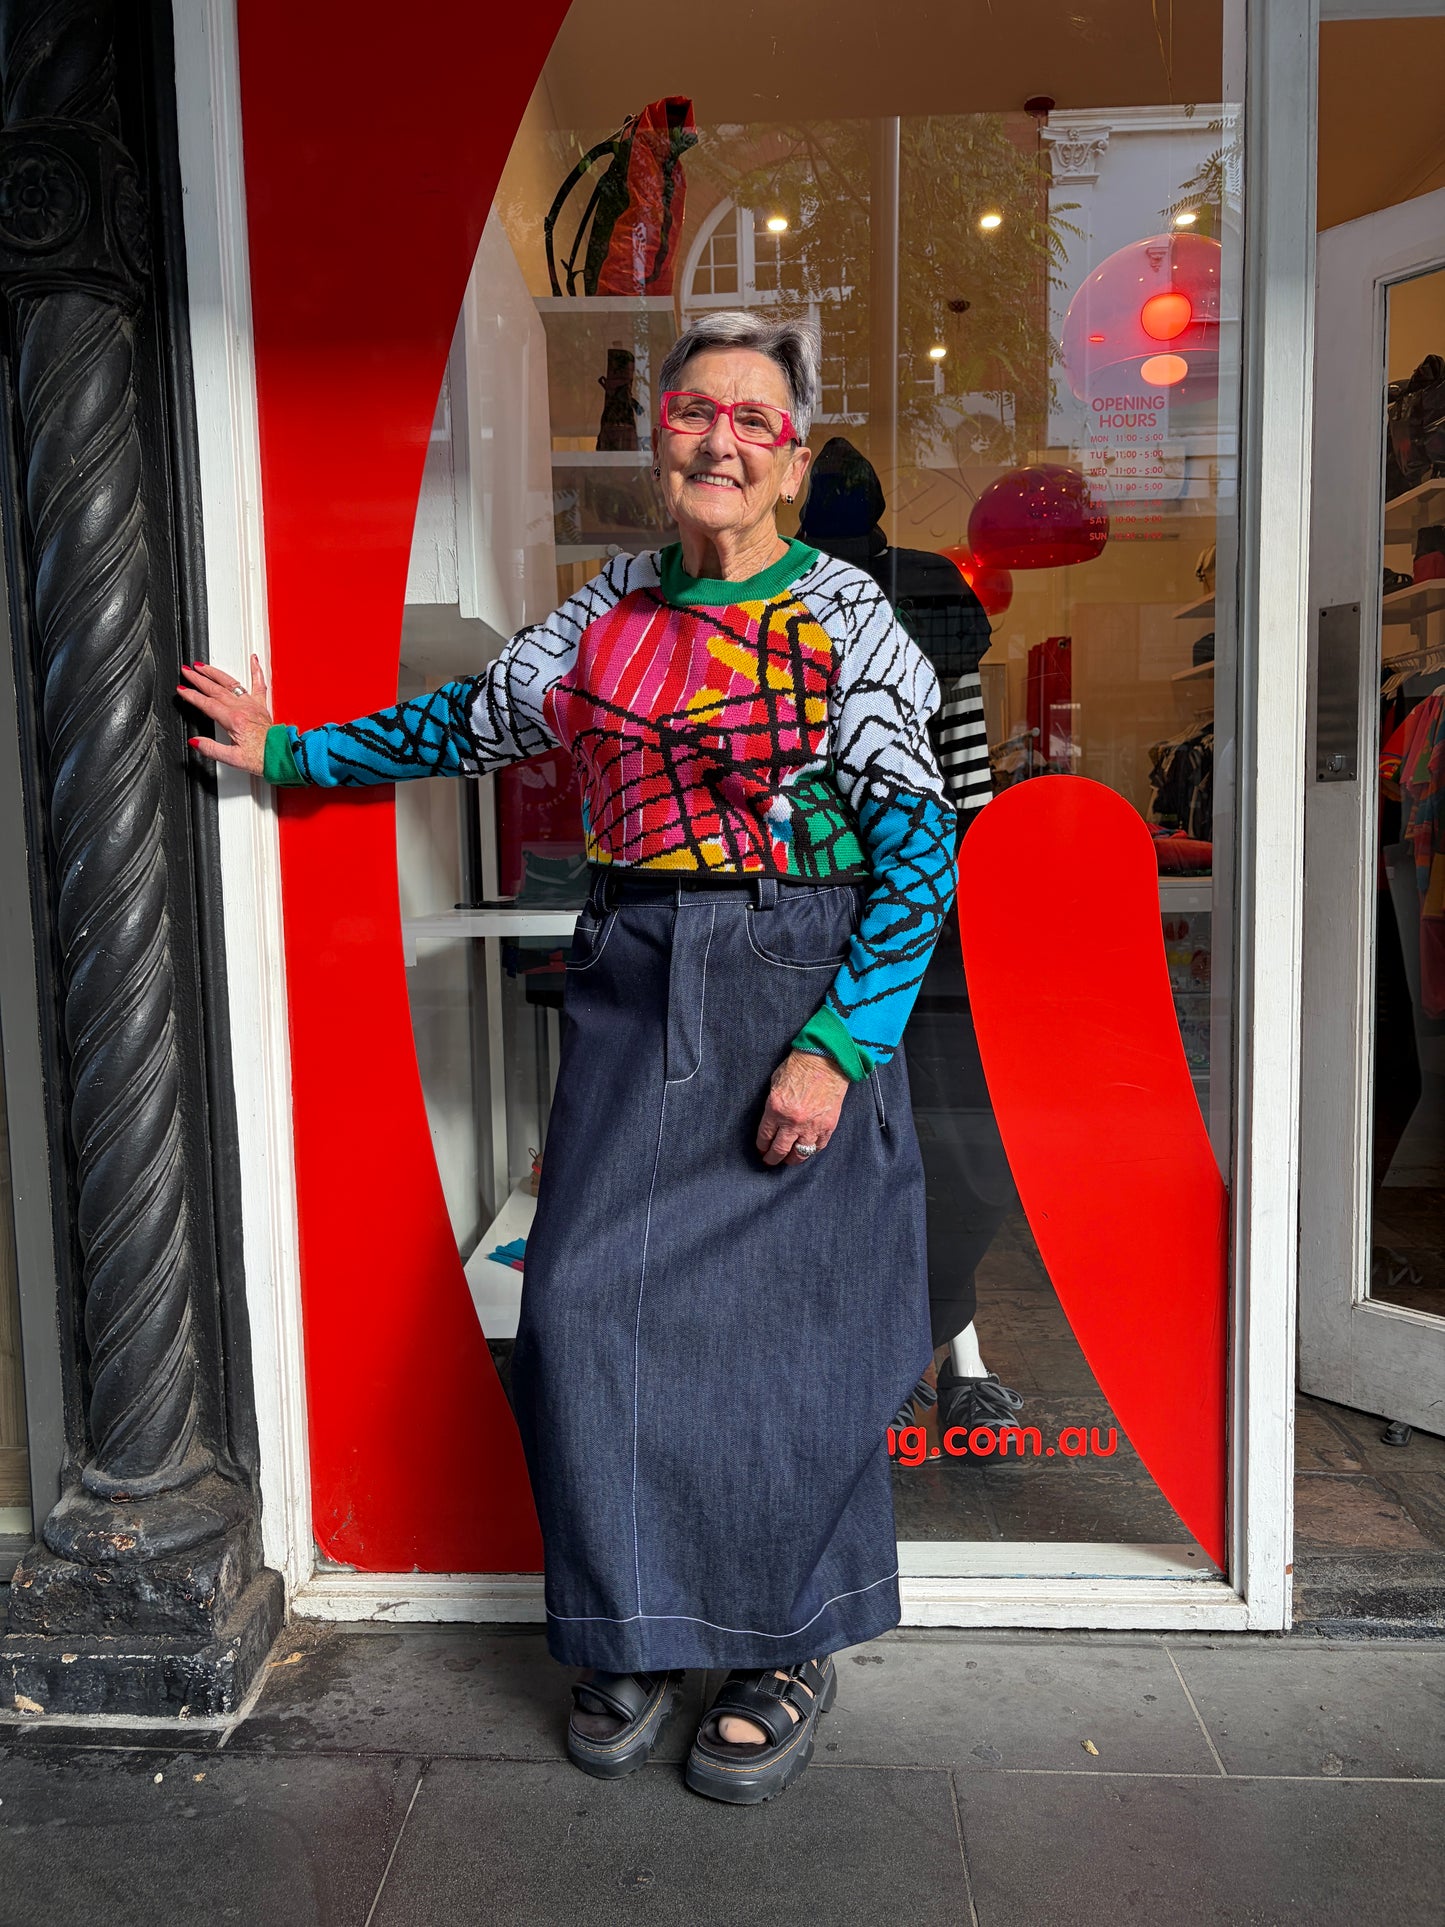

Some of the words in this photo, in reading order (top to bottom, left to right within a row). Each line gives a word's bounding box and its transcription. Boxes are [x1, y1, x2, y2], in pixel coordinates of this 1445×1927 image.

[1092, 395, 1165, 412] OPENING
[1099, 412, 1157, 428] HOURS
[1090, 435, 1109, 443] MON
[1145, 433, 1164, 442] 5:00
[1090, 451, 1108, 459] TUE
[1116, 450, 1137, 459] 11:00
[1144, 450, 1163, 459] 5:00
[1090, 468, 1107, 476] WED
[1115, 467, 1137, 475] 11:00
[1144, 466, 1163, 475] 5:00
[1089, 516, 1107, 524] SAT
[1089, 532, 1107, 540] SUN
